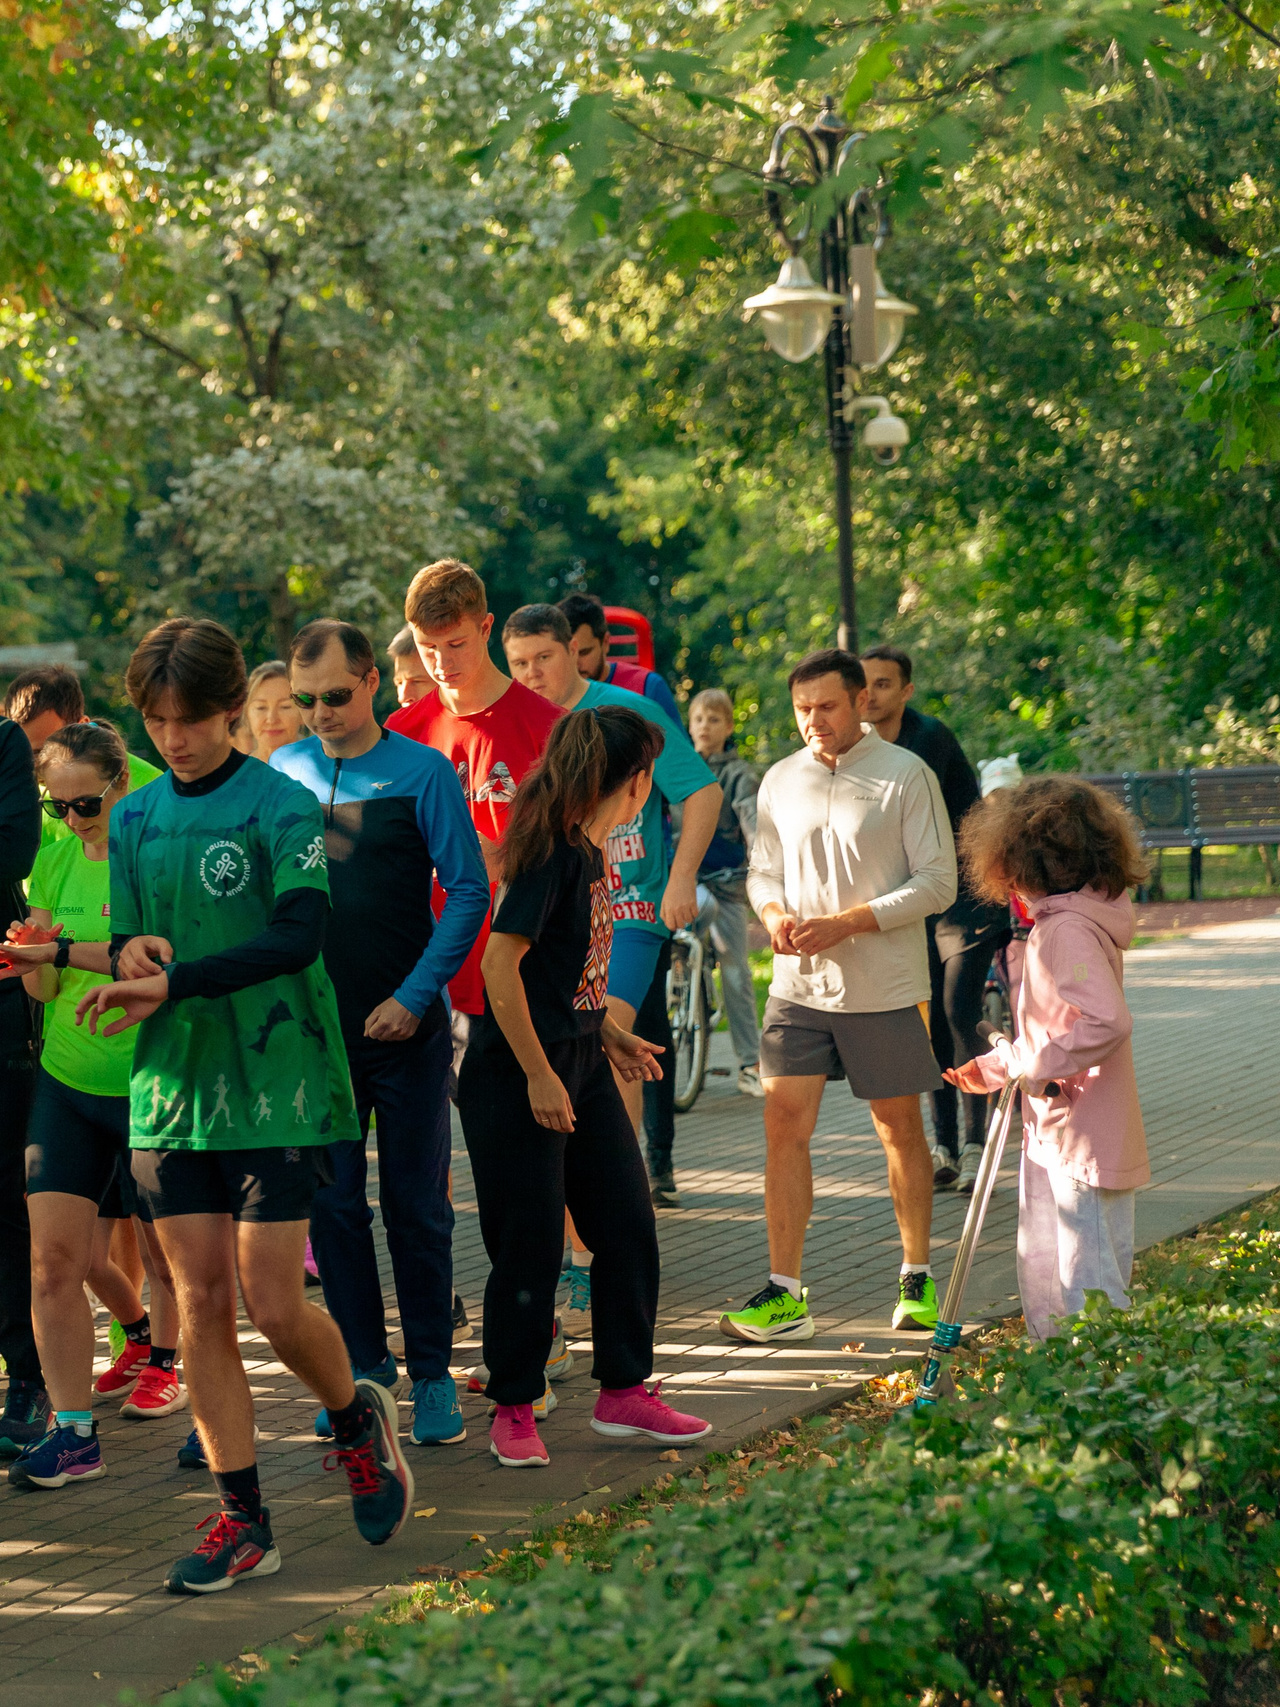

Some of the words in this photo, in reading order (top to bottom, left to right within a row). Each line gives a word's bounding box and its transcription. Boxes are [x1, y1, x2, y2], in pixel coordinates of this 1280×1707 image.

[205, 840, 245, 856] #RUZARUN
[606, 833, 644, 863] МЕН
[200, 857, 223, 897] #RUZARUN
[226, 858, 251, 897] #RUZARUN
